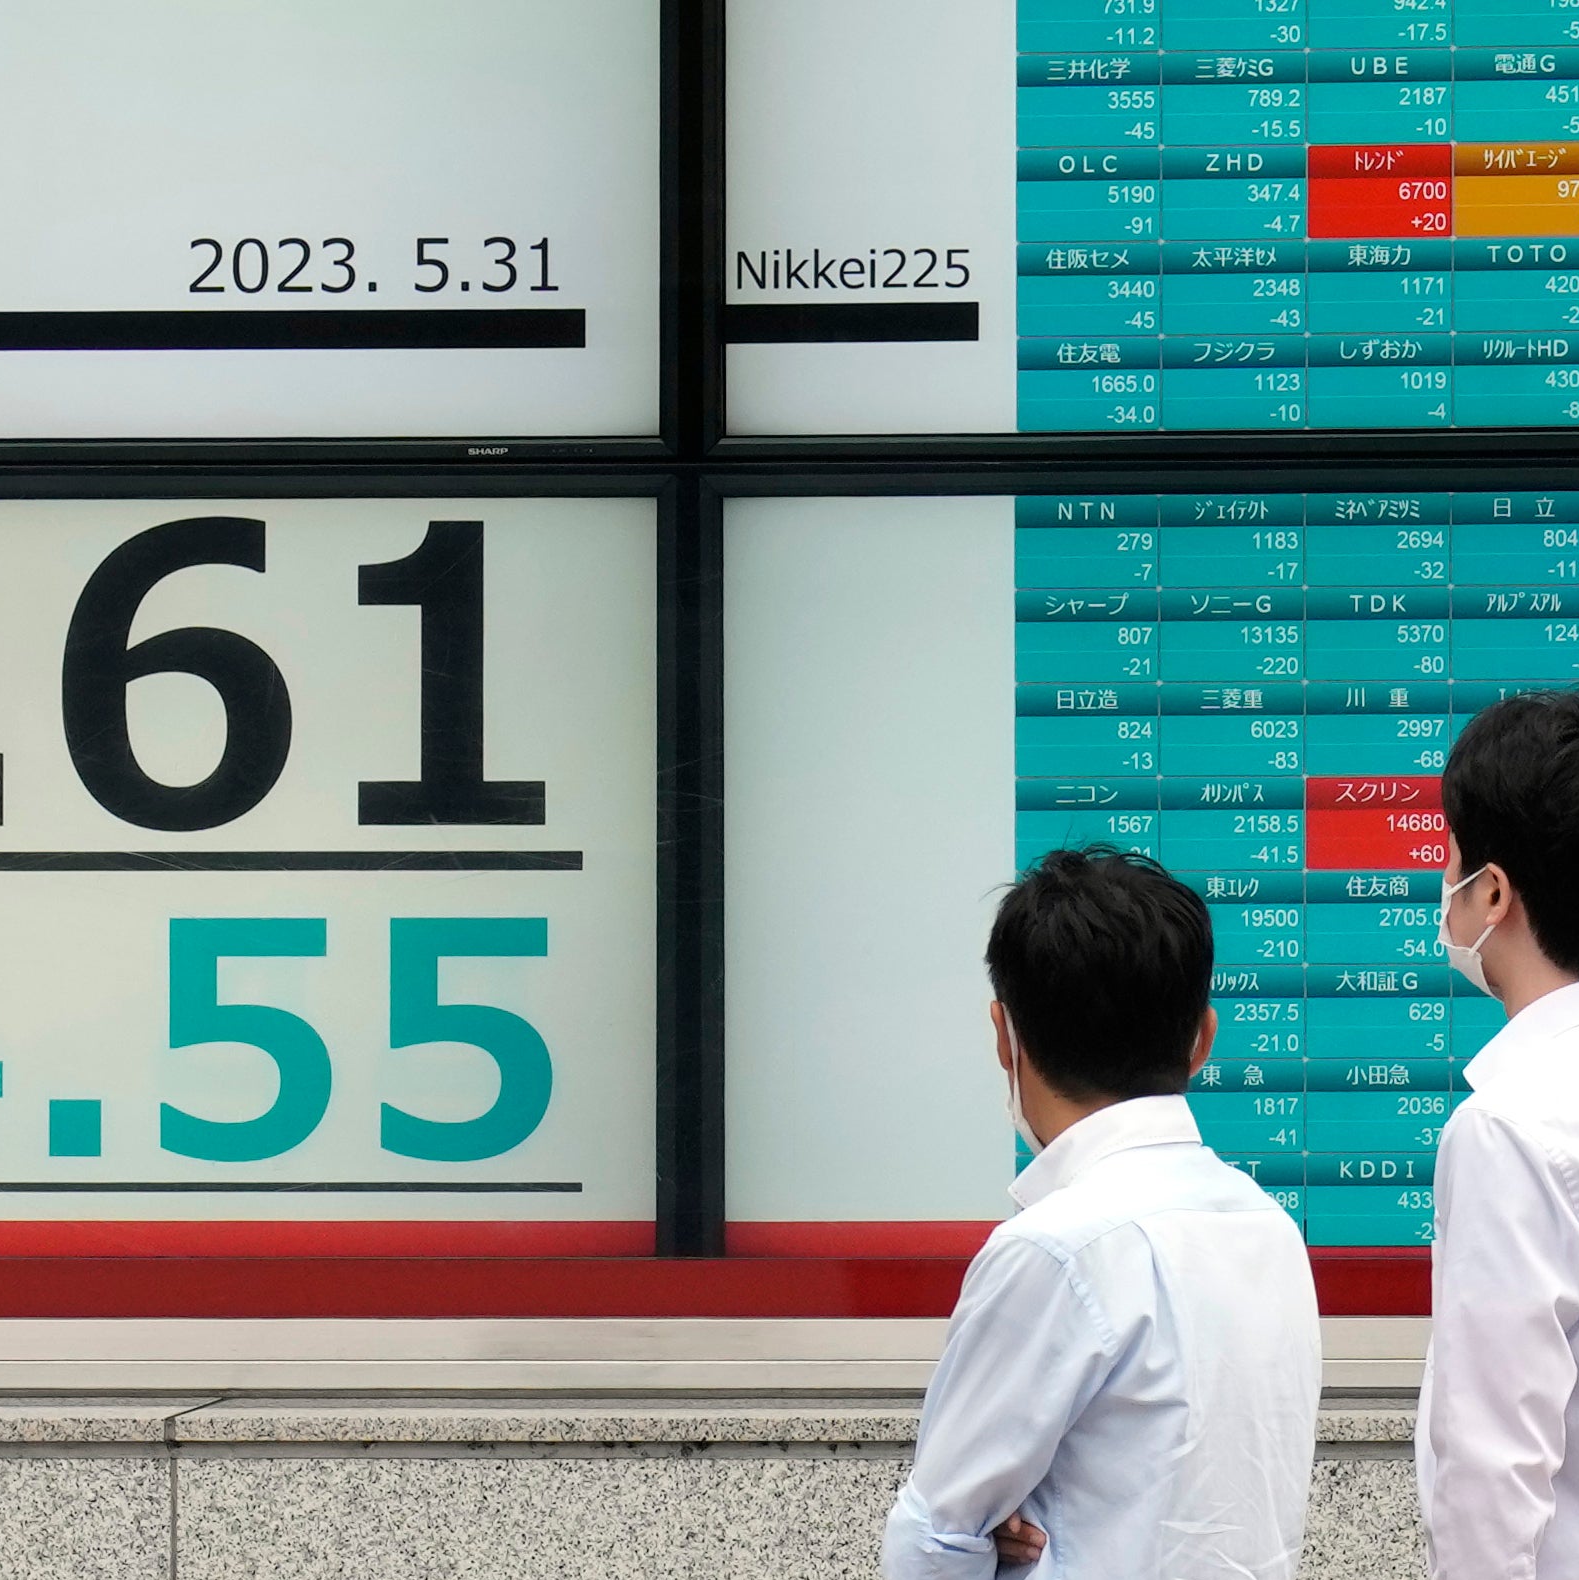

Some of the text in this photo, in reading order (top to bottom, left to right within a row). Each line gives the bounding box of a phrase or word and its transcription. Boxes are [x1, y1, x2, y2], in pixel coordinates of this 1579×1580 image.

[1047, 57, 1131, 81] 三井化学
[1494, 53, 1556, 74] 電通G
[1247, 88, 1301, 108] 789.2
[1398, 181, 1447, 200] 6700
[190, 237, 559, 293] 2023. 5.31
[736, 248, 970, 290] Nikkei225
[1045, 248, 1130, 270] 住阪セメ
[1253, 278, 1301, 297] 2348
[1400, 276, 1444, 295] 1171
[1056, 342, 1121, 364] 住友電
[1194, 341, 1275, 362] フジクラ
[1340, 339, 1423, 361] しずおか
[467, 447, 509, 456] SHARP
[1252, 531, 1299, 550] 1183
[1396, 530, 1445, 549] 2694
[1045, 592, 1130, 616] シャープ
[1191, 594, 1272, 615] ソニーG
[1056, 689, 1119, 710] 日立造
[1200, 688, 1264, 710] 三菱重
[1396, 719, 1445, 738] 2997
[1055, 785, 1118, 804] ニコン
[1335, 782, 1420, 803] スクリン
[1233, 814, 1299, 834] 2158.5
[1345, 875, 1409, 897] 住友商
[1241, 908, 1299, 928] 19500
[1335, 970, 1418, 992] 大和証G
[1346, 1063, 1410, 1086] 小田急
[1255, 1097, 1298, 1115] 1817
